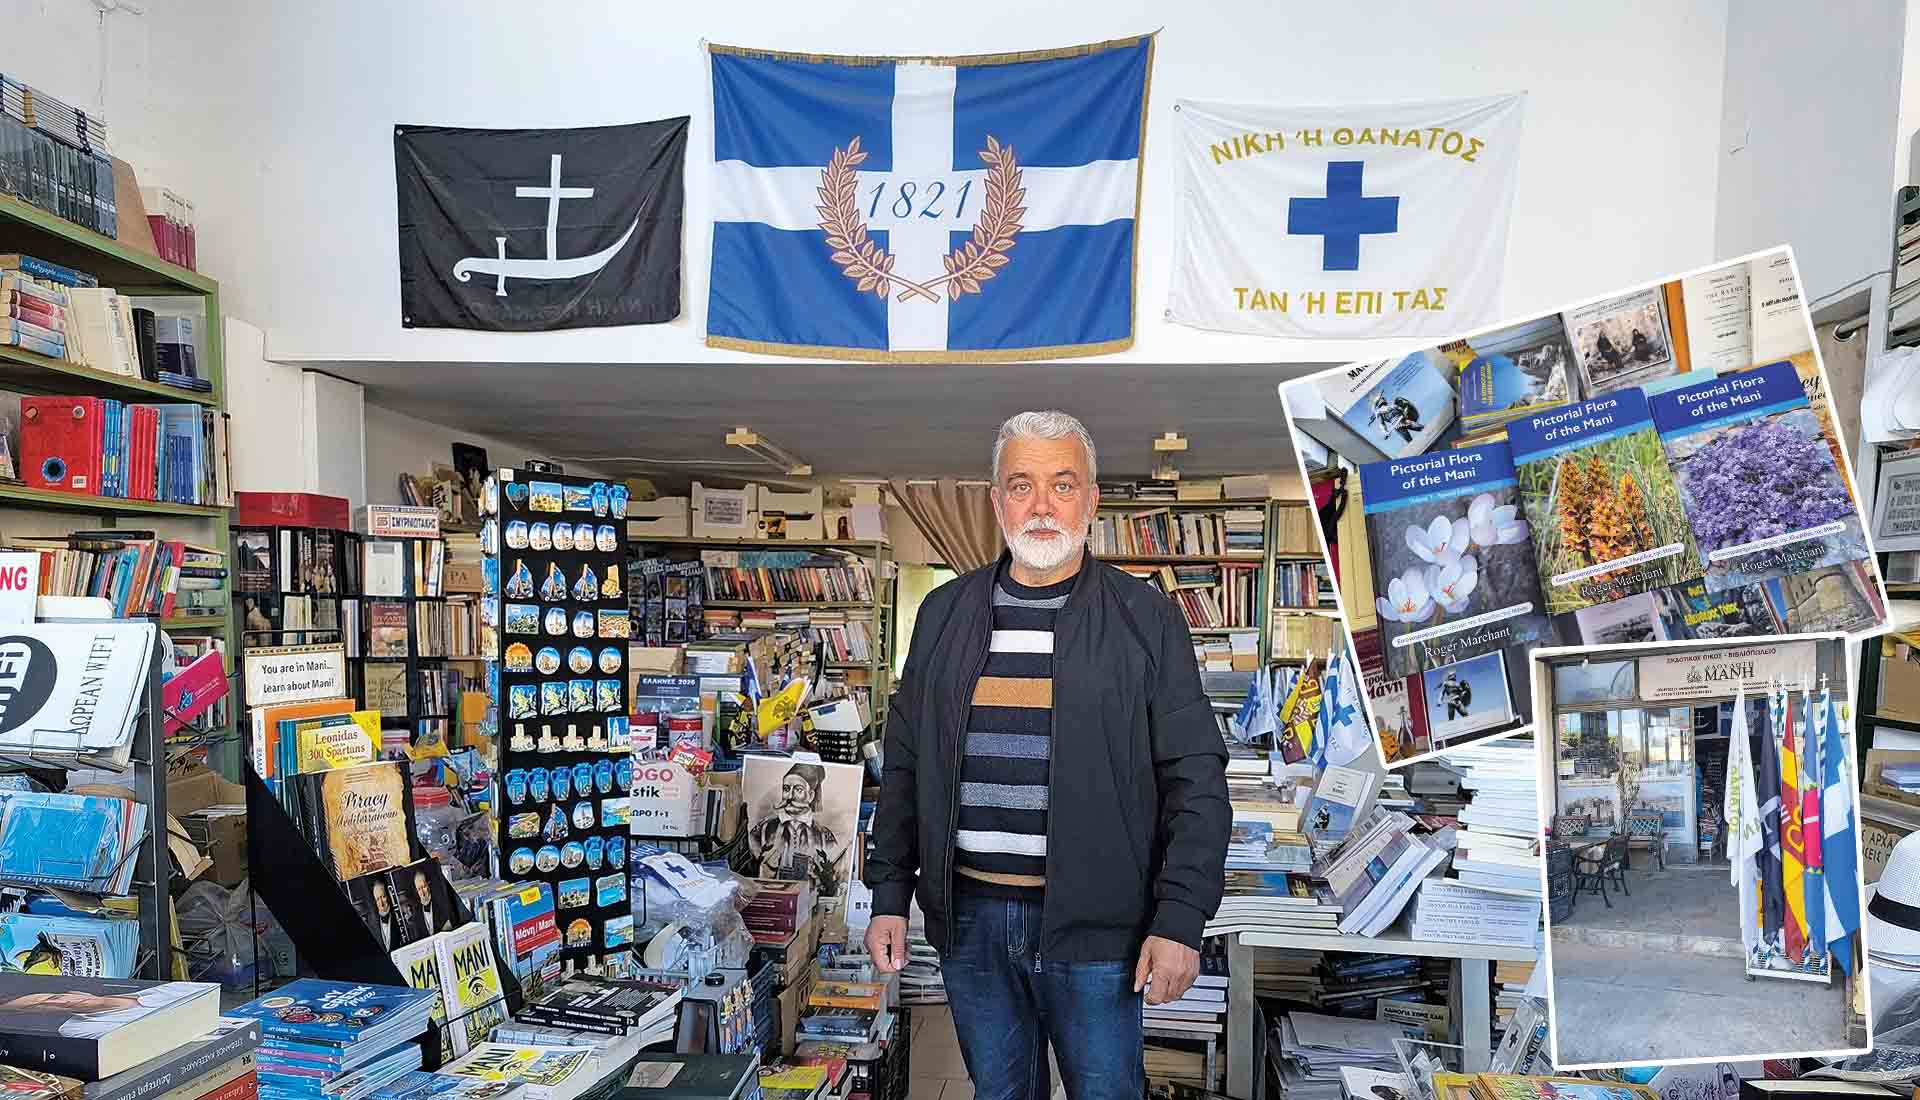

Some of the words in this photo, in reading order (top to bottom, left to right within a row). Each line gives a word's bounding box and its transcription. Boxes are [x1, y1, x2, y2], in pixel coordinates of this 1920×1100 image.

[1208, 131, 1285, 165] ΝΙΚΗ
[1332, 127, 1487, 163] ΘΑΝΑΤΟΣ
[868, 180, 972, 219] 1821
[1233, 287, 1289, 313] ΤΑΝ
[1335, 291, 1383, 315] ΕΠΙ
[1392, 287, 1449, 311] ΤΑΣ
[1677, 383, 1729, 405] Pictorial
[1731, 375, 1766, 390] Flora
[1533, 407, 1582, 429] Pictorial
[1585, 399, 1617, 415] Flora
[1691, 405, 1706, 417] of
[1707, 400, 1728, 413] the
[1731, 390, 1761, 407] Mani
[1545, 429, 1559, 440] of
[1560, 424, 1581, 437] the
[1583, 414, 1613, 431] Mani
[1390, 459, 1446, 477] Pictorial
[1449, 453, 1483, 466] Flora
[1402, 478, 1417, 489] of
[1419, 474, 1441, 487] the
[1445, 467, 1477, 481] Mani
[1740, 557, 1774, 572] Roger
[1775, 544, 1826, 565] Marchant
[1581, 582, 1614, 598] Roger
[1615, 567, 1664, 587] Marchant
[1423, 638, 1458, 658] Roger
[1459, 626, 1511, 649] Marchant
[261, 664, 278, 674] You
[279, 664, 295, 673] are
[296, 662, 305, 672] in
[1704, 666, 1754, 681] ΜΑΝΗ
[263, 684, 287, 693] Learn
[287, 681, 310, 691] about
[311, 678, 334, 689] Mani!
[69, 676, 105, 735] ΔΩΡΕΑΝ
[315, 729, 359, 745] Leonidas
[307, 750, 324, 761] 300
[326, 742, 366, 759] Spartans
[341, 791, 390, 810] Piracy
[632, 786, 660, 798] stik
[515, 926, 535, 939] Μάνη
[452, 939, 490, 980] MANI
[464, 1048, 517, 1076] MANI
[138, 1072, 172, 1096] Δεύτερη
